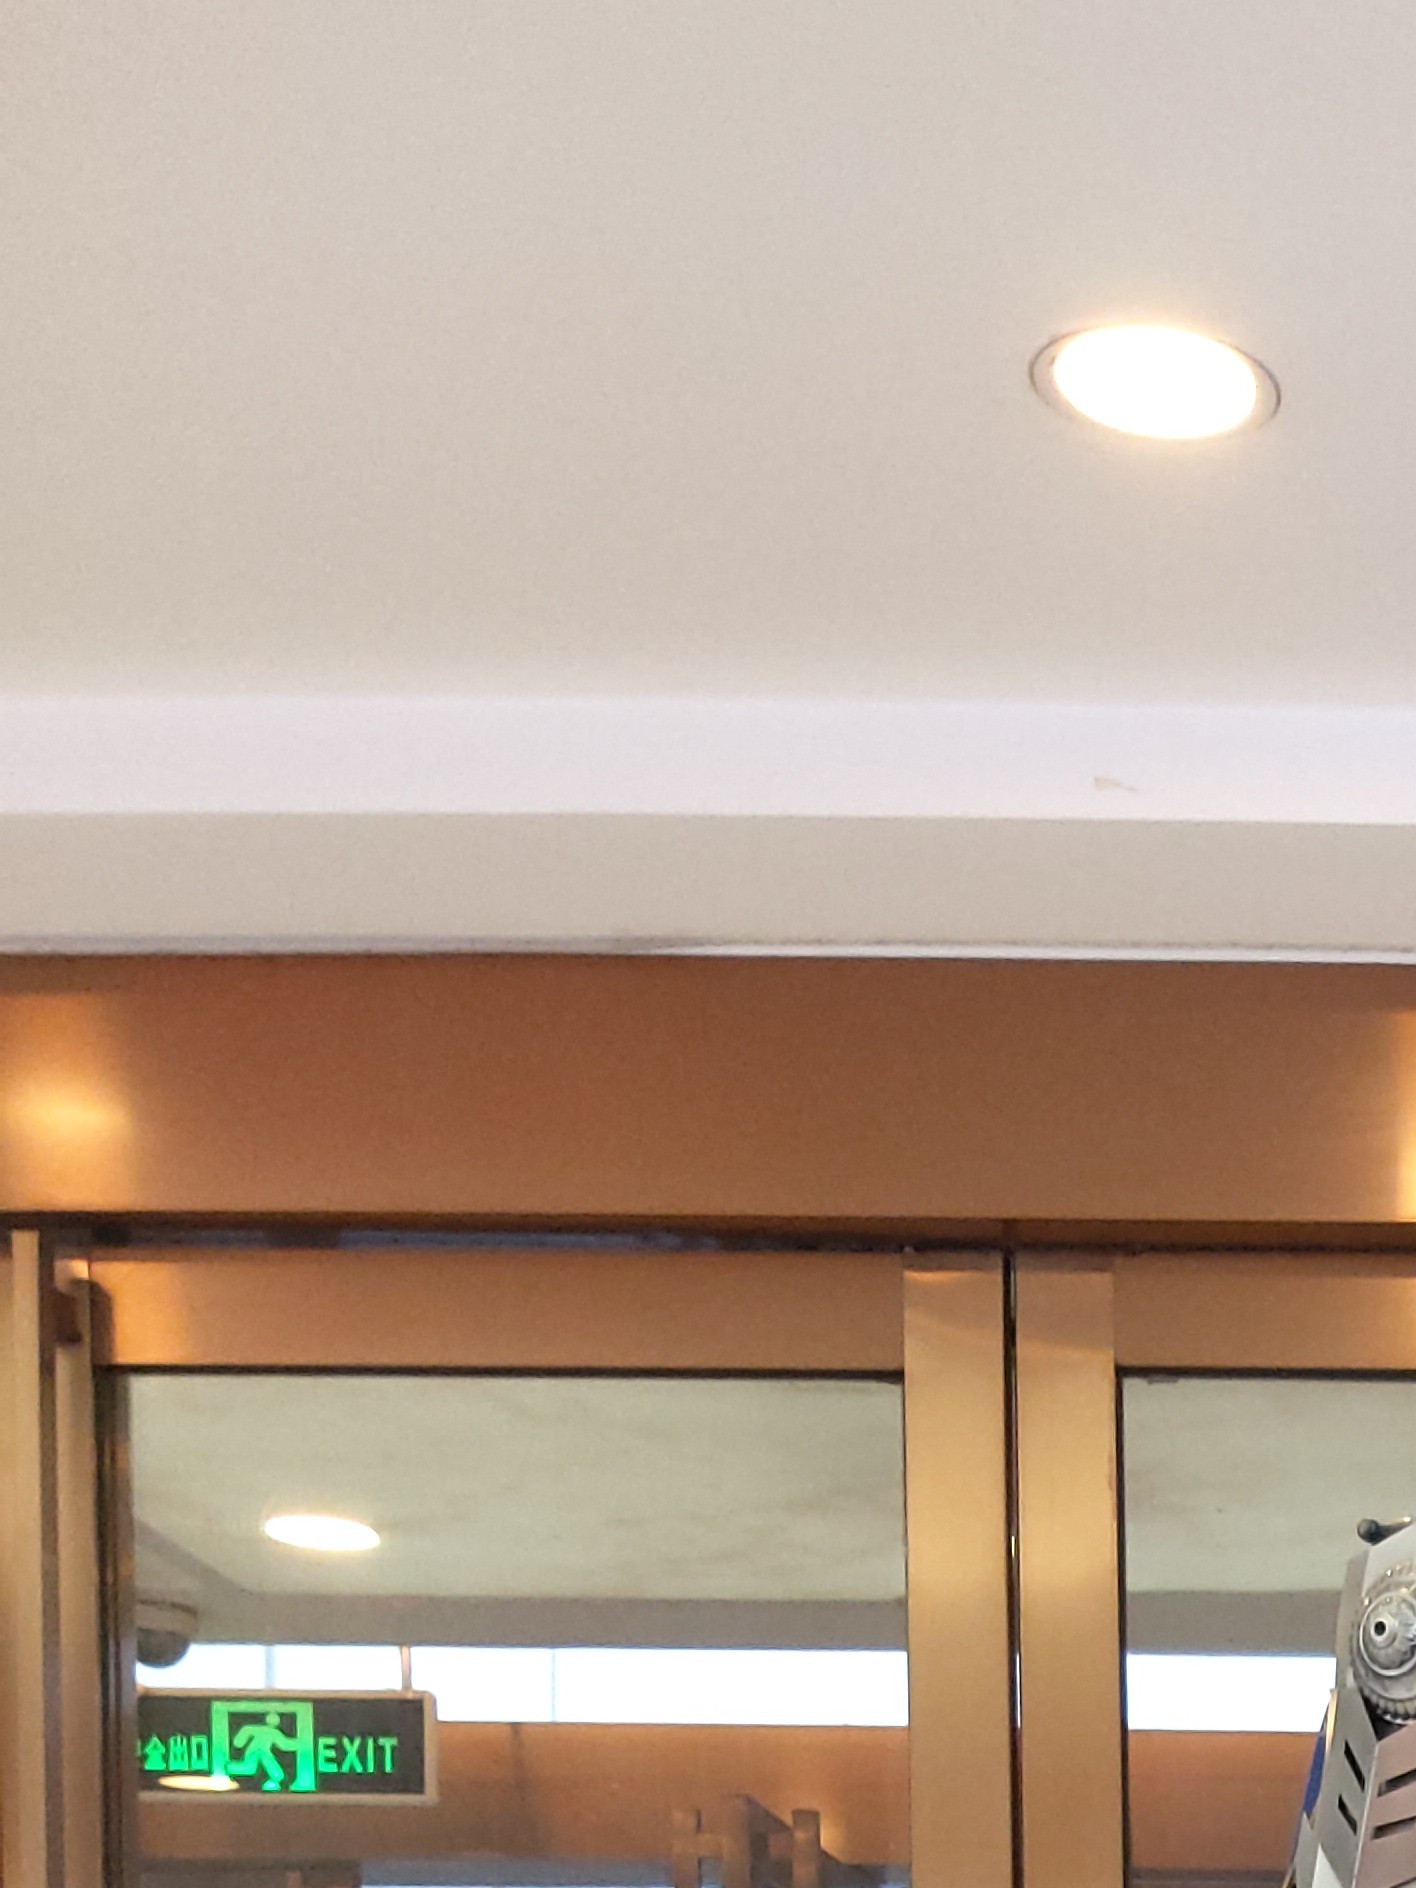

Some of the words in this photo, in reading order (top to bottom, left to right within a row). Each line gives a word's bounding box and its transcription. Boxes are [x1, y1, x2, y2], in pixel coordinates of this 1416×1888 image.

[137, 1734, 208, 1771] 全出口
[318, 1736, 399, 1773] EXIT
